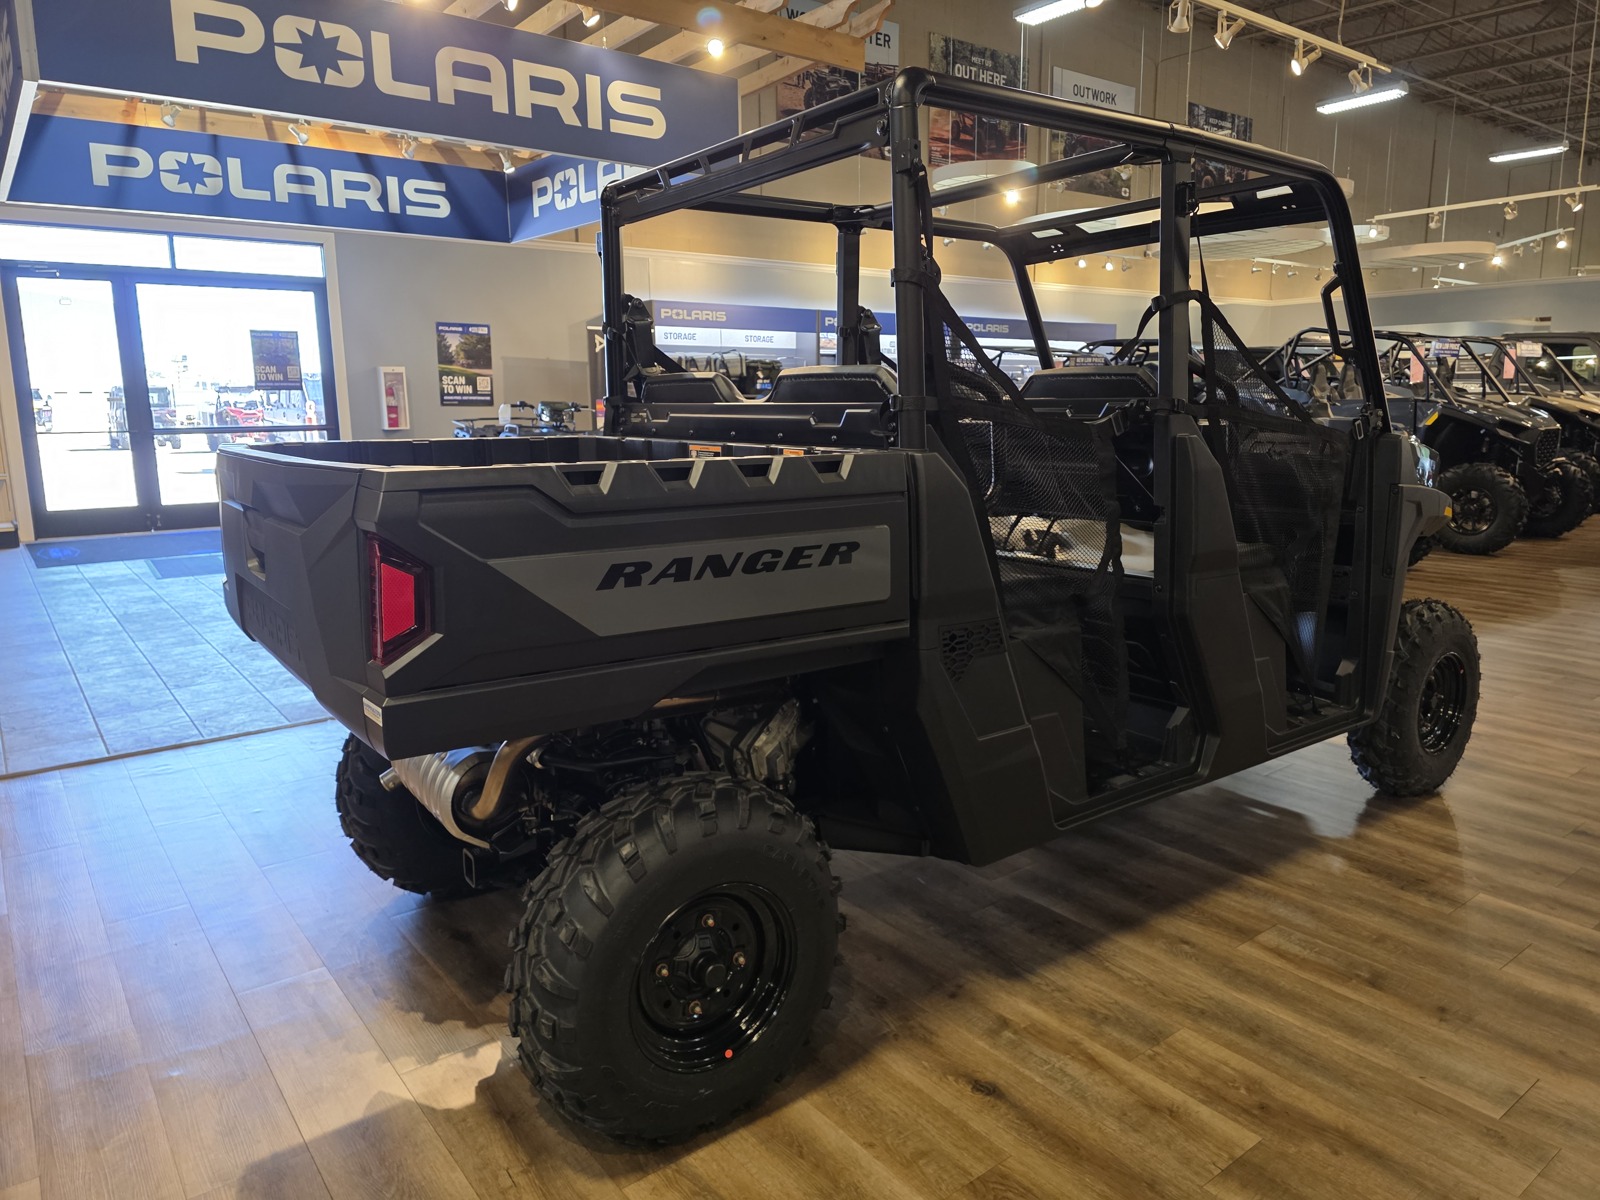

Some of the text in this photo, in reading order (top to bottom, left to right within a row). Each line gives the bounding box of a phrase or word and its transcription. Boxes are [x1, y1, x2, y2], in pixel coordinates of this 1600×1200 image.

[172, 0, 667, 140] POLARIS
[954, 64, 1007, 86] OUT HERE
[1072, 84, 1117, 106] OUTWORK
[89, 142, 451, 218] POLARIS
[531, 160, 650, 218] POLA
[660, 308, 727, 322] POLARIS
[966, 323, 1009, 333] POLARIS
[663, 331, 697, 341] STORAGE
[744, 335, 774, 343] STORAGE
[255, 365, 277, 373] SCAN
[255, 373, 283, 381] TO WIN
[442, 375, 466, 385] SCAN
[443, 384, 454, 394] TO
[455, 385, 473, 394] WIN
[595, 541, 861, 591] RANGER
